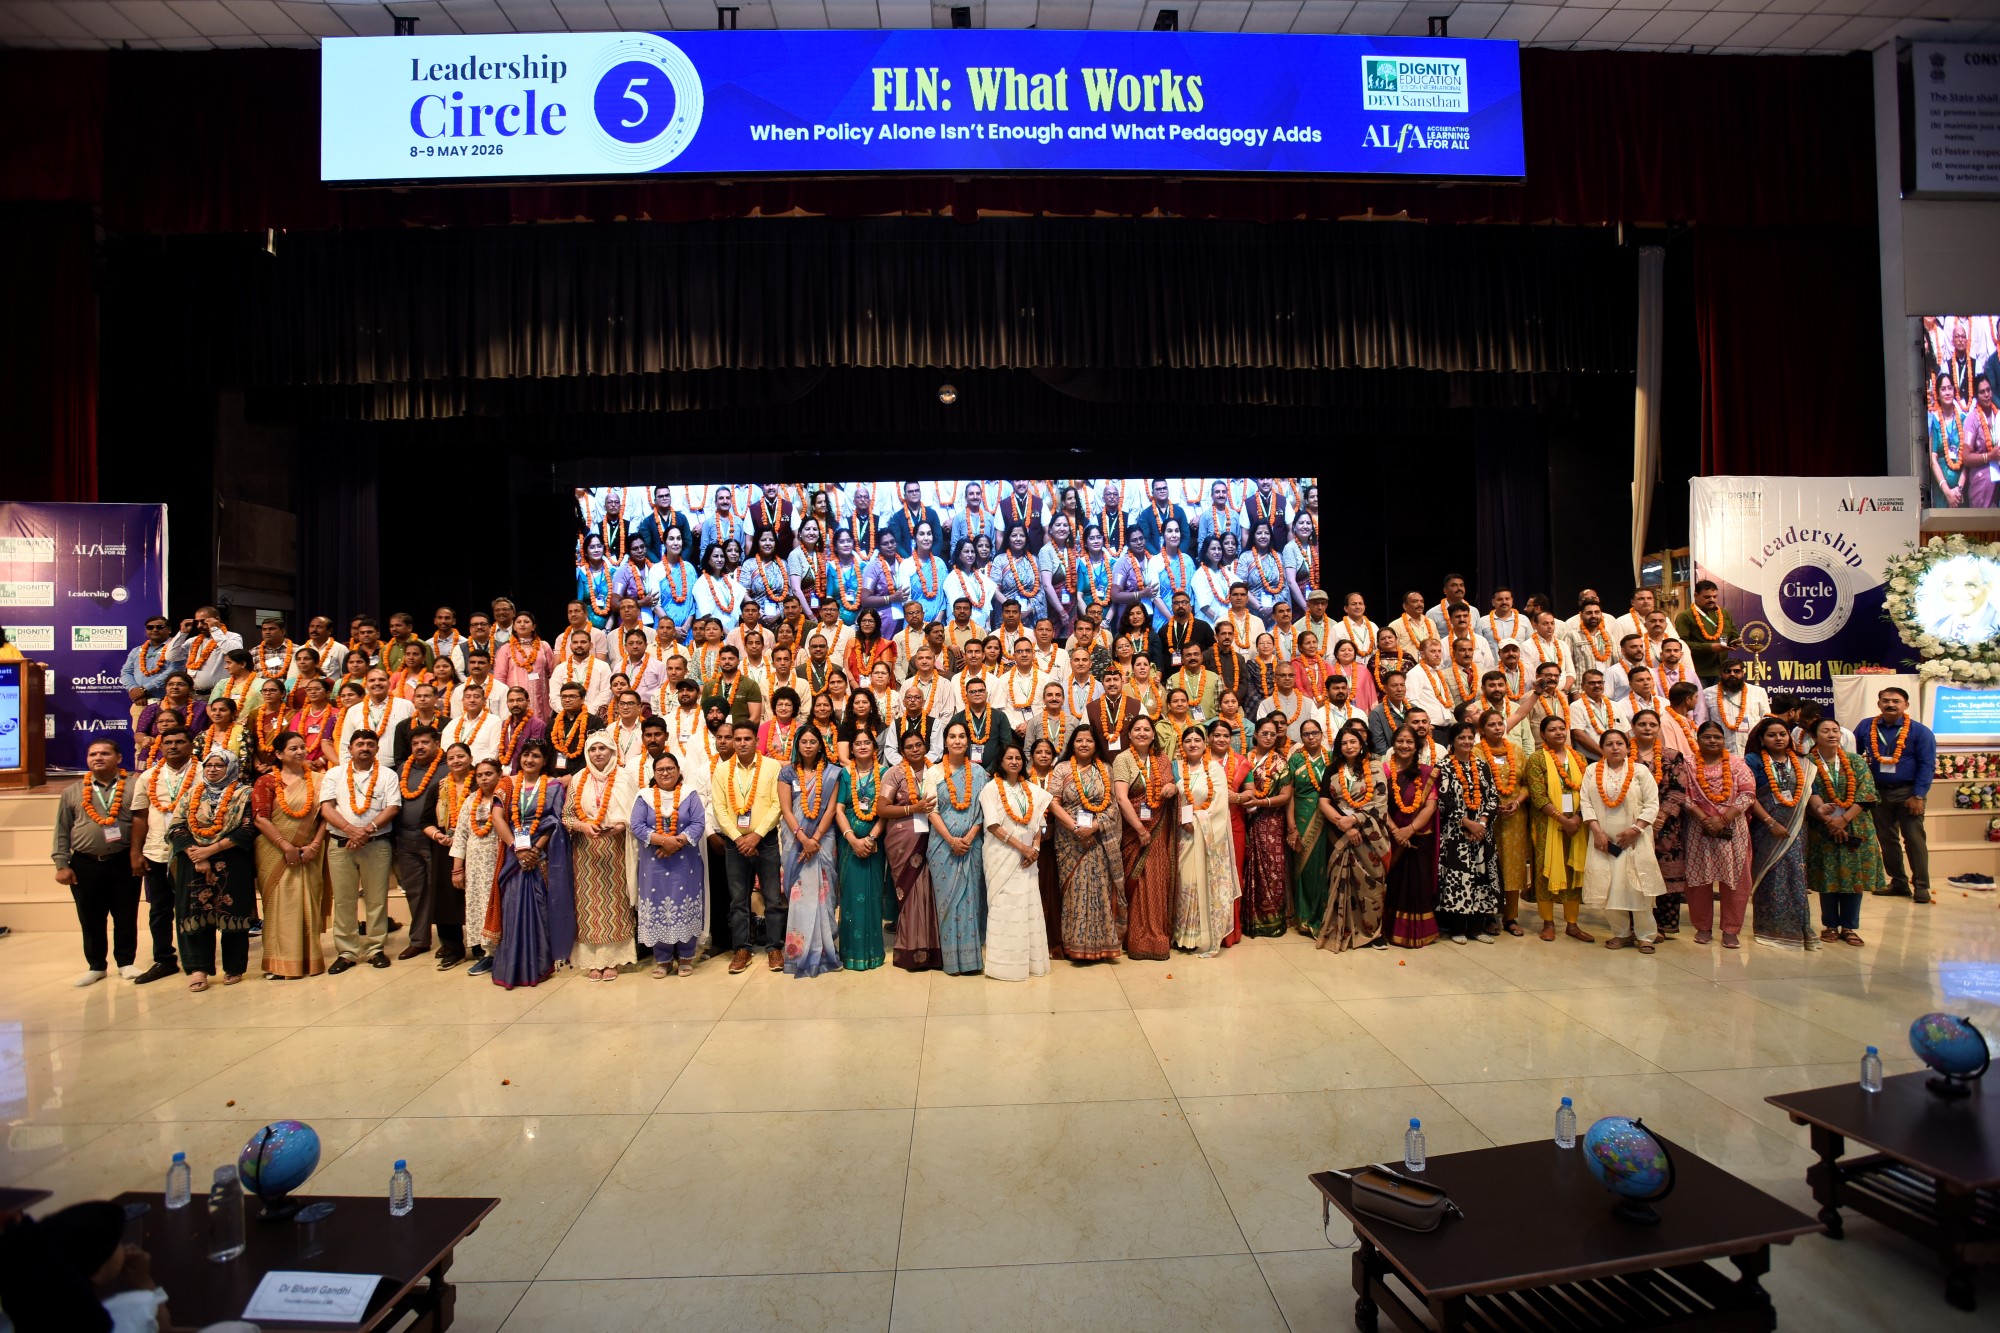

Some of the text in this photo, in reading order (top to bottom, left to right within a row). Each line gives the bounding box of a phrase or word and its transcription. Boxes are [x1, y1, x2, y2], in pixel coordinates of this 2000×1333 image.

[1964, 52, 2000, 66] CONS
[411, 55, 567, 83] Leadership
[1400, 62, 1460, 76] DIGNITY
[1400, 75, 1461, 86] EDUCATION
[872, 67, 1204, 113] FLN: What Works
[620, 78, 651, 127] 5
[1368, 95, 1461, 108] DEVI Sansthan
[1930, 92, 1998, 103] The State shall
[410, 89, 567, 140] Circle
[750, 124, 811, 141] When
[814, 123, 875, 145] Policy
[879, 123, 936, 141] Alone
[989, 123, 1064, 144] Enough
[1067, 124, 1106, 141] and
[1110, 124, 1165, 141] What
[1169, 124, 1267, 146] Pedagogy
[1273, 125, 1322, 143] Adds
[1427, 132, 1470, 140] LEARNING
[437, 144, 468, 157] MAY
[470, 144, 504, 156] 2026
[1427, 140, 1470, 150] FOR ALL
[1728, 492, 1762, 500] DIGNITY
[1750, 525, 1862, 569] Leadership
[68, 590, 110, 598] Leadership
[1783, 582, 1833, 598] Circle
[1802, 600, 1814, 620] 5
[1778, 660, 1822, 681] What
[1767, 686, 1794, 694] Policy
[278, 1284, 291, 1292] Dr
[320, 1285, 352, 1296] Gandhi
